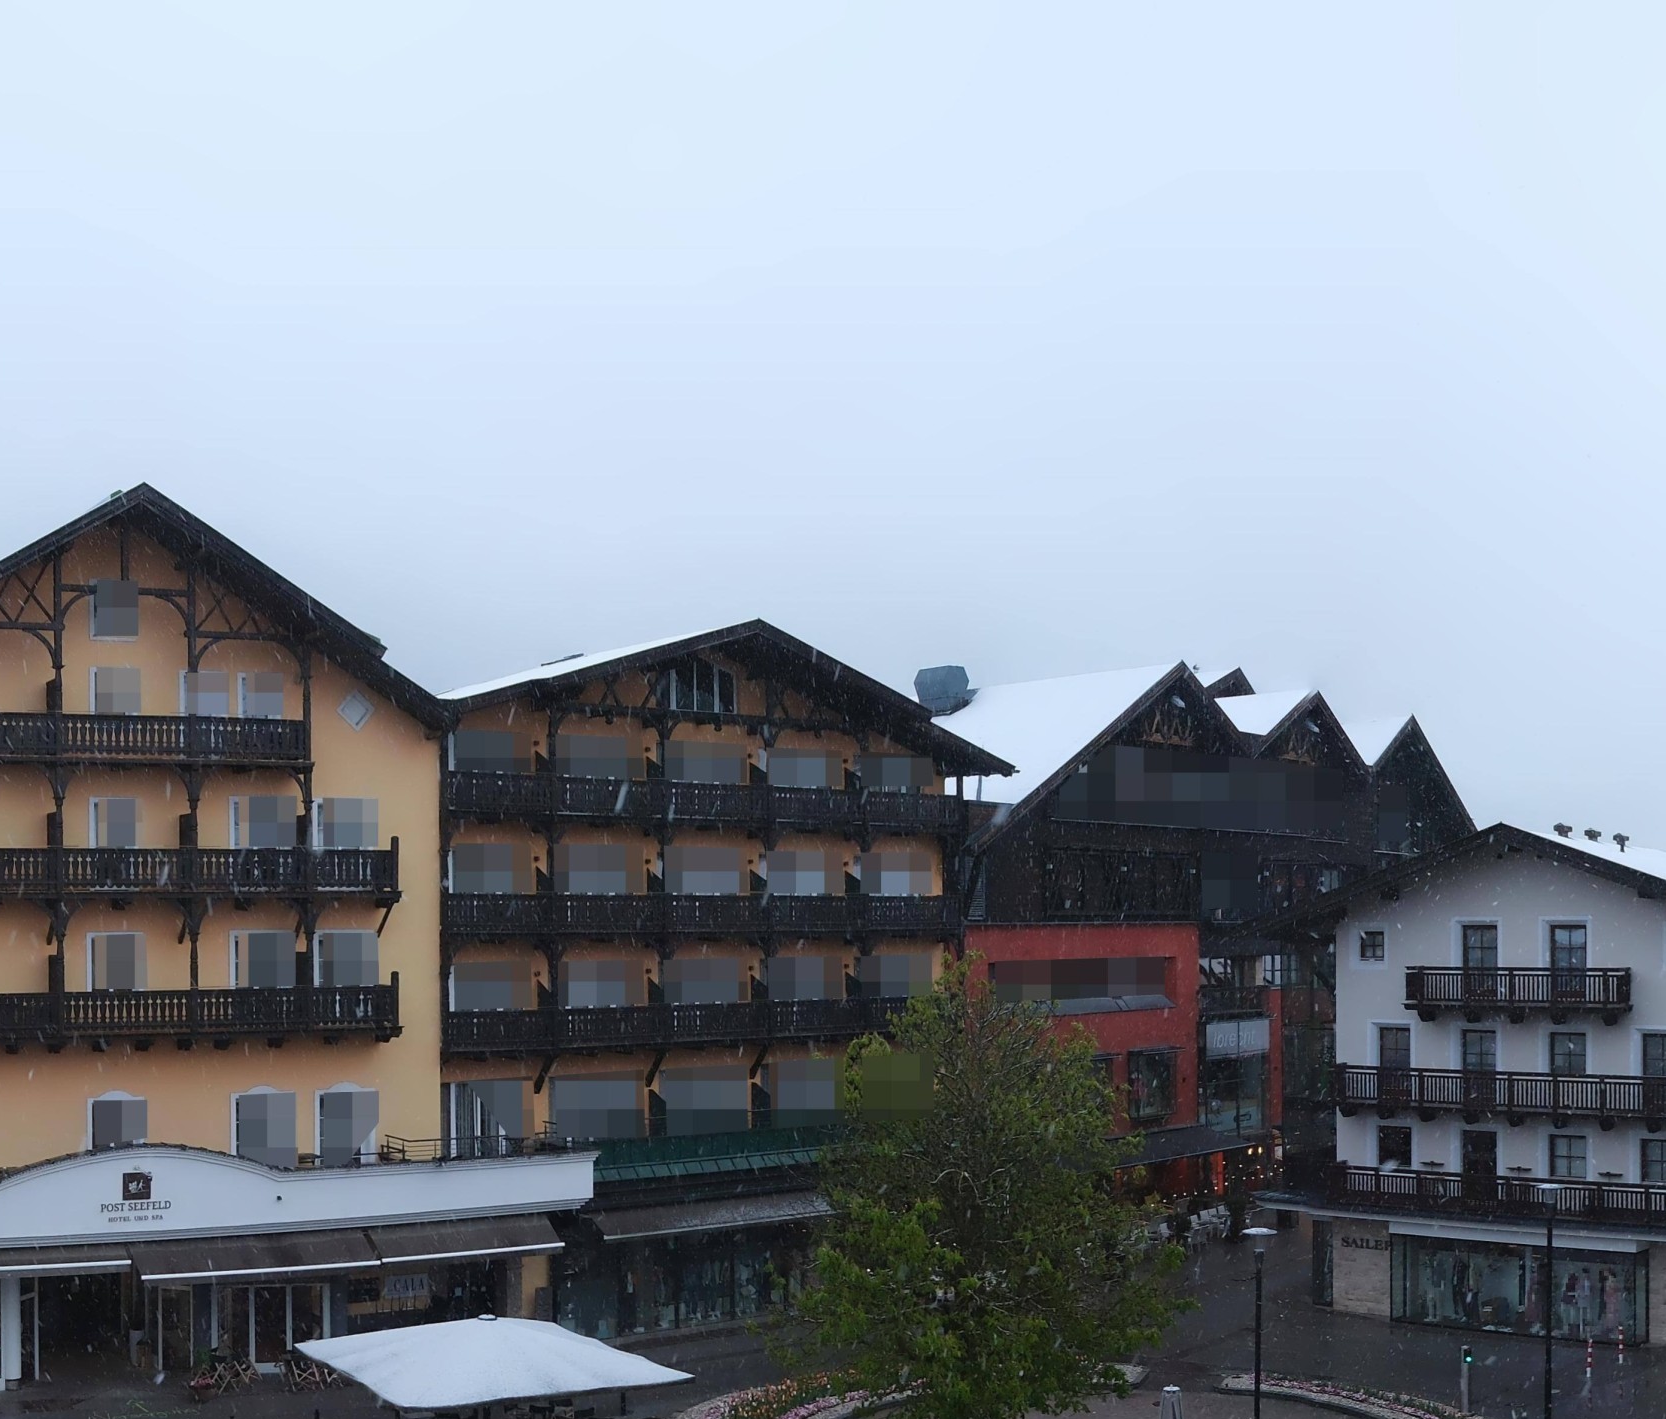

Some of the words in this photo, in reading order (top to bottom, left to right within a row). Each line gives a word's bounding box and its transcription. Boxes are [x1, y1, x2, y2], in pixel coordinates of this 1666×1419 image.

[100, 1203, 126, 1213] POST
[128, 1200, 172, 1211] SEEFELD
[108, 1215, 131, 1223] HOTEL
